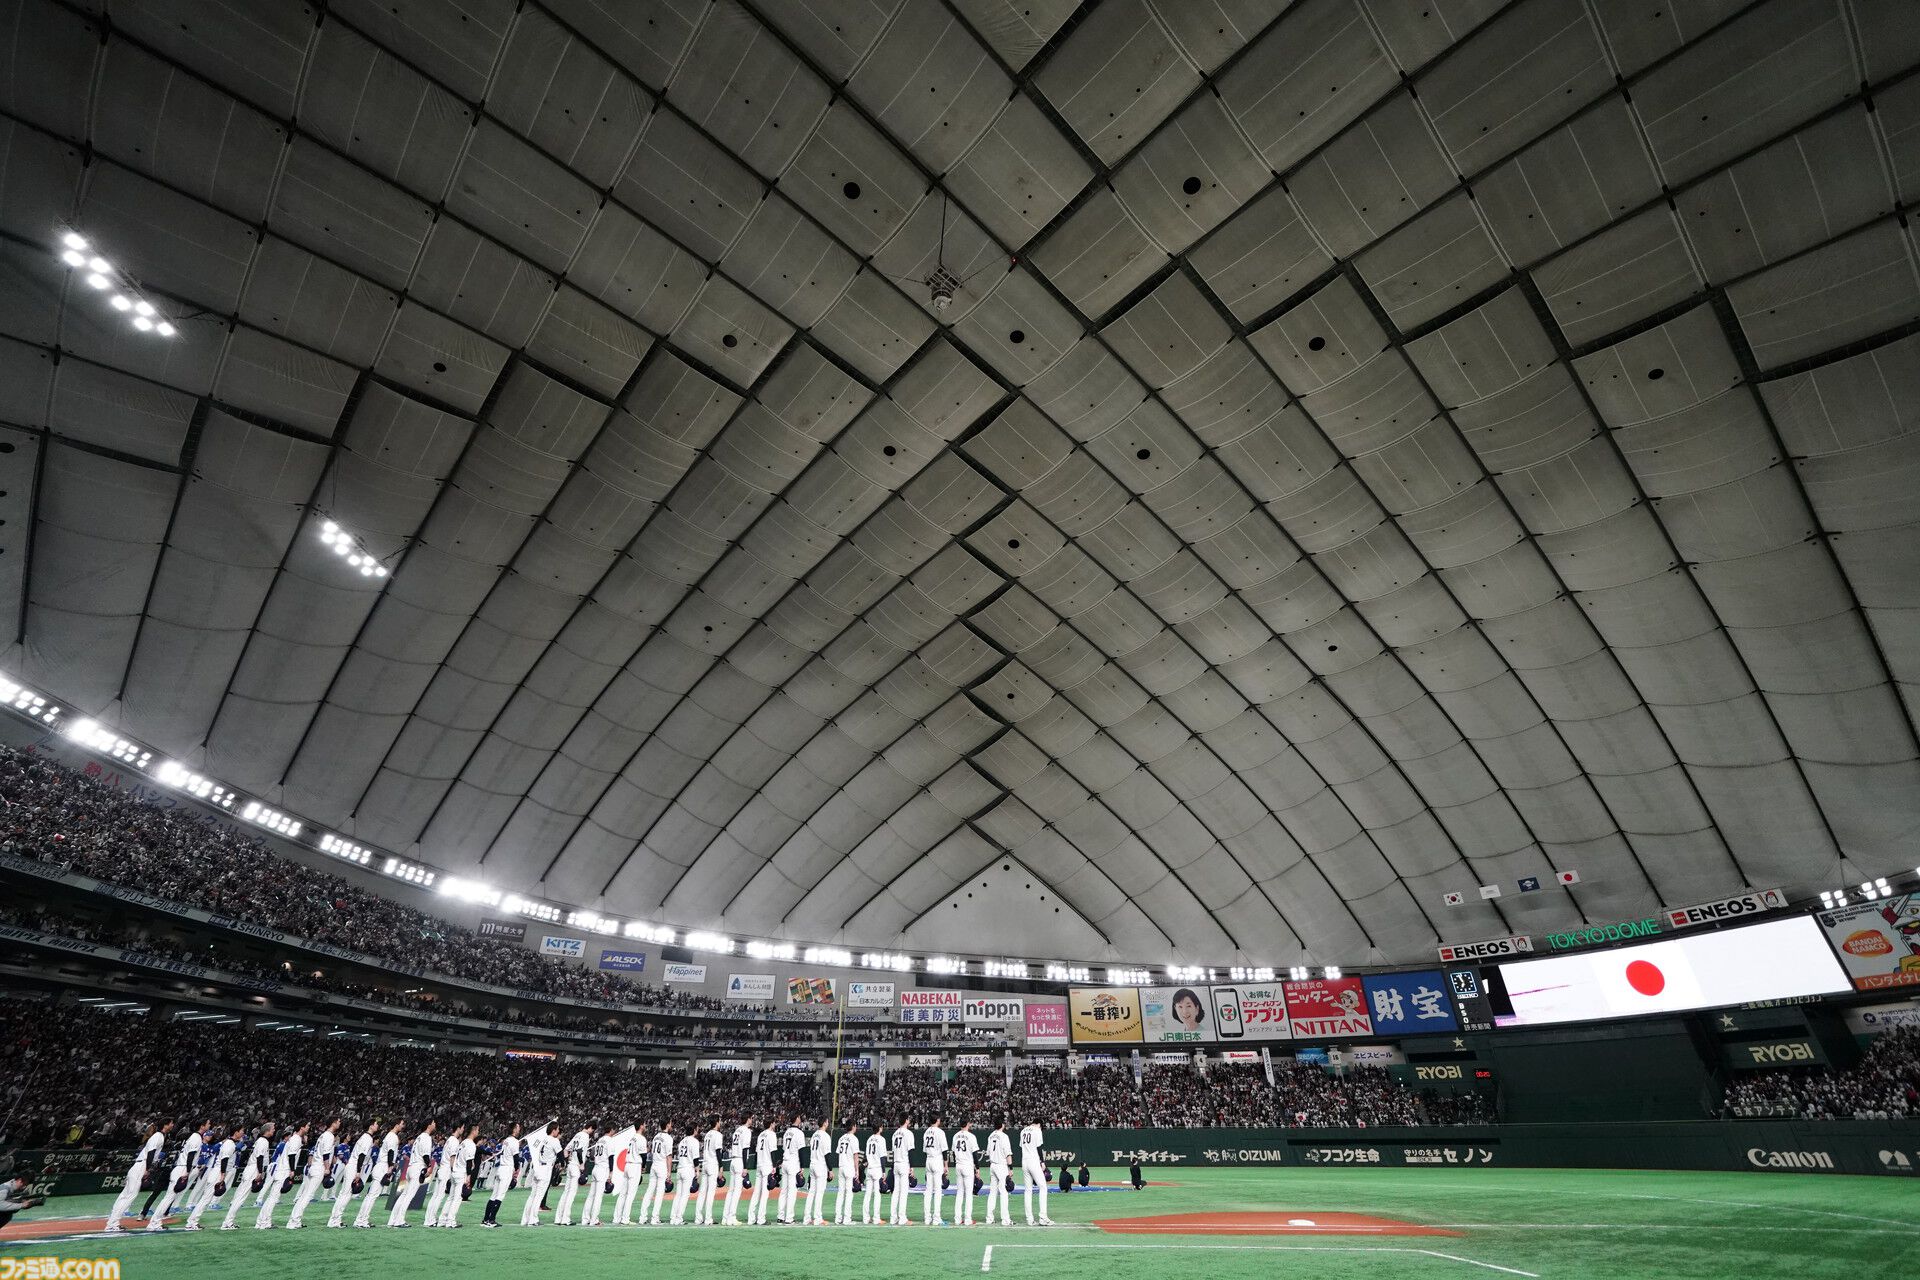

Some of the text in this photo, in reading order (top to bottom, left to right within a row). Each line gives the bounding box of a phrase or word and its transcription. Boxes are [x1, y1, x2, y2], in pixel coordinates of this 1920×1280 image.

[1687, 896, 1758, 923] ENEOS
[238, 921, 284, 942] SHINRYO
[1546, 919, 1662, 950] TOKYO DOME
[546, 938, 582, 950] KITZ
[1848, 935, 1883, 948] BANDAI
[1852, 942, 1887, 953] NAMCO
[1452, 940, 1511, 959] ENEOS
[611, 955, 643, 965] ALSOK
[666, 965, 703, 977] Happinet
[865, 985, 892, 993] 共立製薬
[1249, 990, 1271, 999] お得な
[1287, 989, 1335, 1004] ニッタン
[966, 1000, 1020, 1019] nippn
[1372, 986, 1449, 1023] 財宝
[902, 1009, 960, 1022] 能美防災
[1081, 1006, 1131, 1021] 一番搾り
[1243, 1007, 1285, 1024] アプリ
[1029, 1022, 1065, 1036] IIJmio
[1294, 1018, 1370, 1036] NITTAN
[1159, 1031, 1202, 1042] JR東日本
[1747, 1042, 1814, 1064] RYOBI
[956, 1055, 989, 1065] 大塚商会
[1070, 1058, 1077, 1066] 14
[1415, 1064, 1463, 1080] RYOBI
[1733, 1104, 1797, 1117] 日本アンテナ
[893, 1136, 903, 1149] 47
[925, 1136, 935, 1148] 22
[1021, 1132, 1032, 1145] 20
[839, 1142, 849, 1154] 57
[868, 1143, 877, 1155] 13
[956, 1139, 967, 1153] 43
[992, 1140, 997, 1151] 7
[1111, 1150, 1187, 1162] アートネイチャー
[1238, 1149, 1282, 1162] OIZUMI
[1319, 1148, 1380, 1163] フコク生命
[1404, 1148, 1493, 1163] 守りの名手 セノン
[1747, 1148, 1835, 1169] Canon
[23, 1182, 56, 1196] AGC
